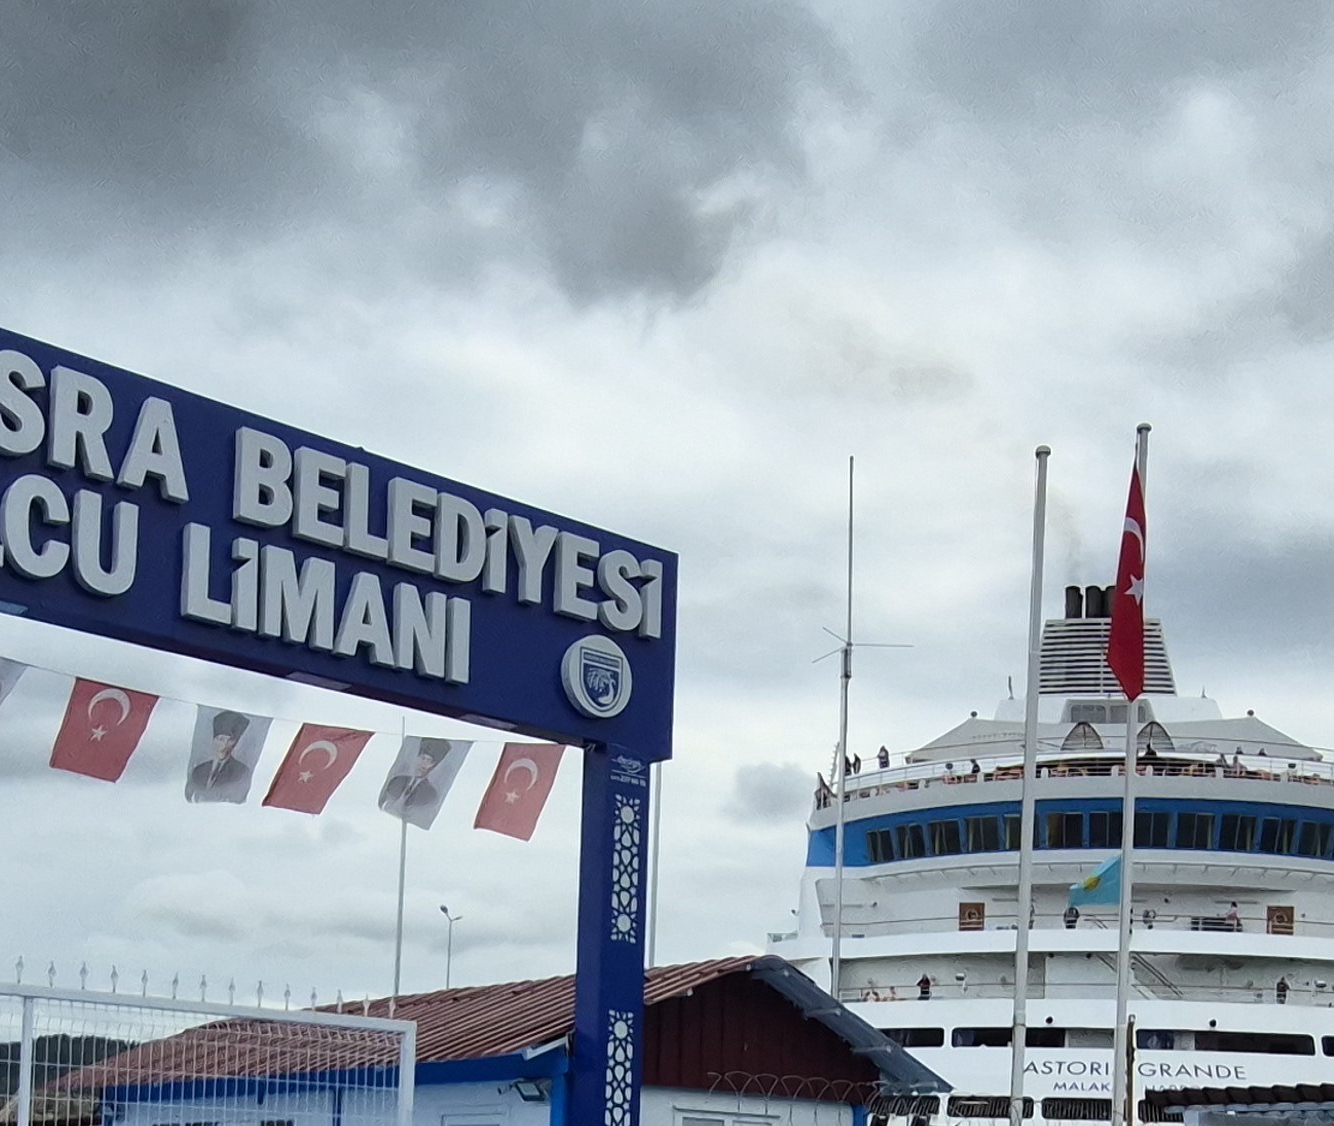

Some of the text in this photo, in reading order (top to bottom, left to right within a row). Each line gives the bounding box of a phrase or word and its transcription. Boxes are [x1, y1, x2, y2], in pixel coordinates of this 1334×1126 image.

[1023, 1061, 1248, 1080] ASTORI GRANDE
[1053, 1081, 1111, 1091] MALAK
